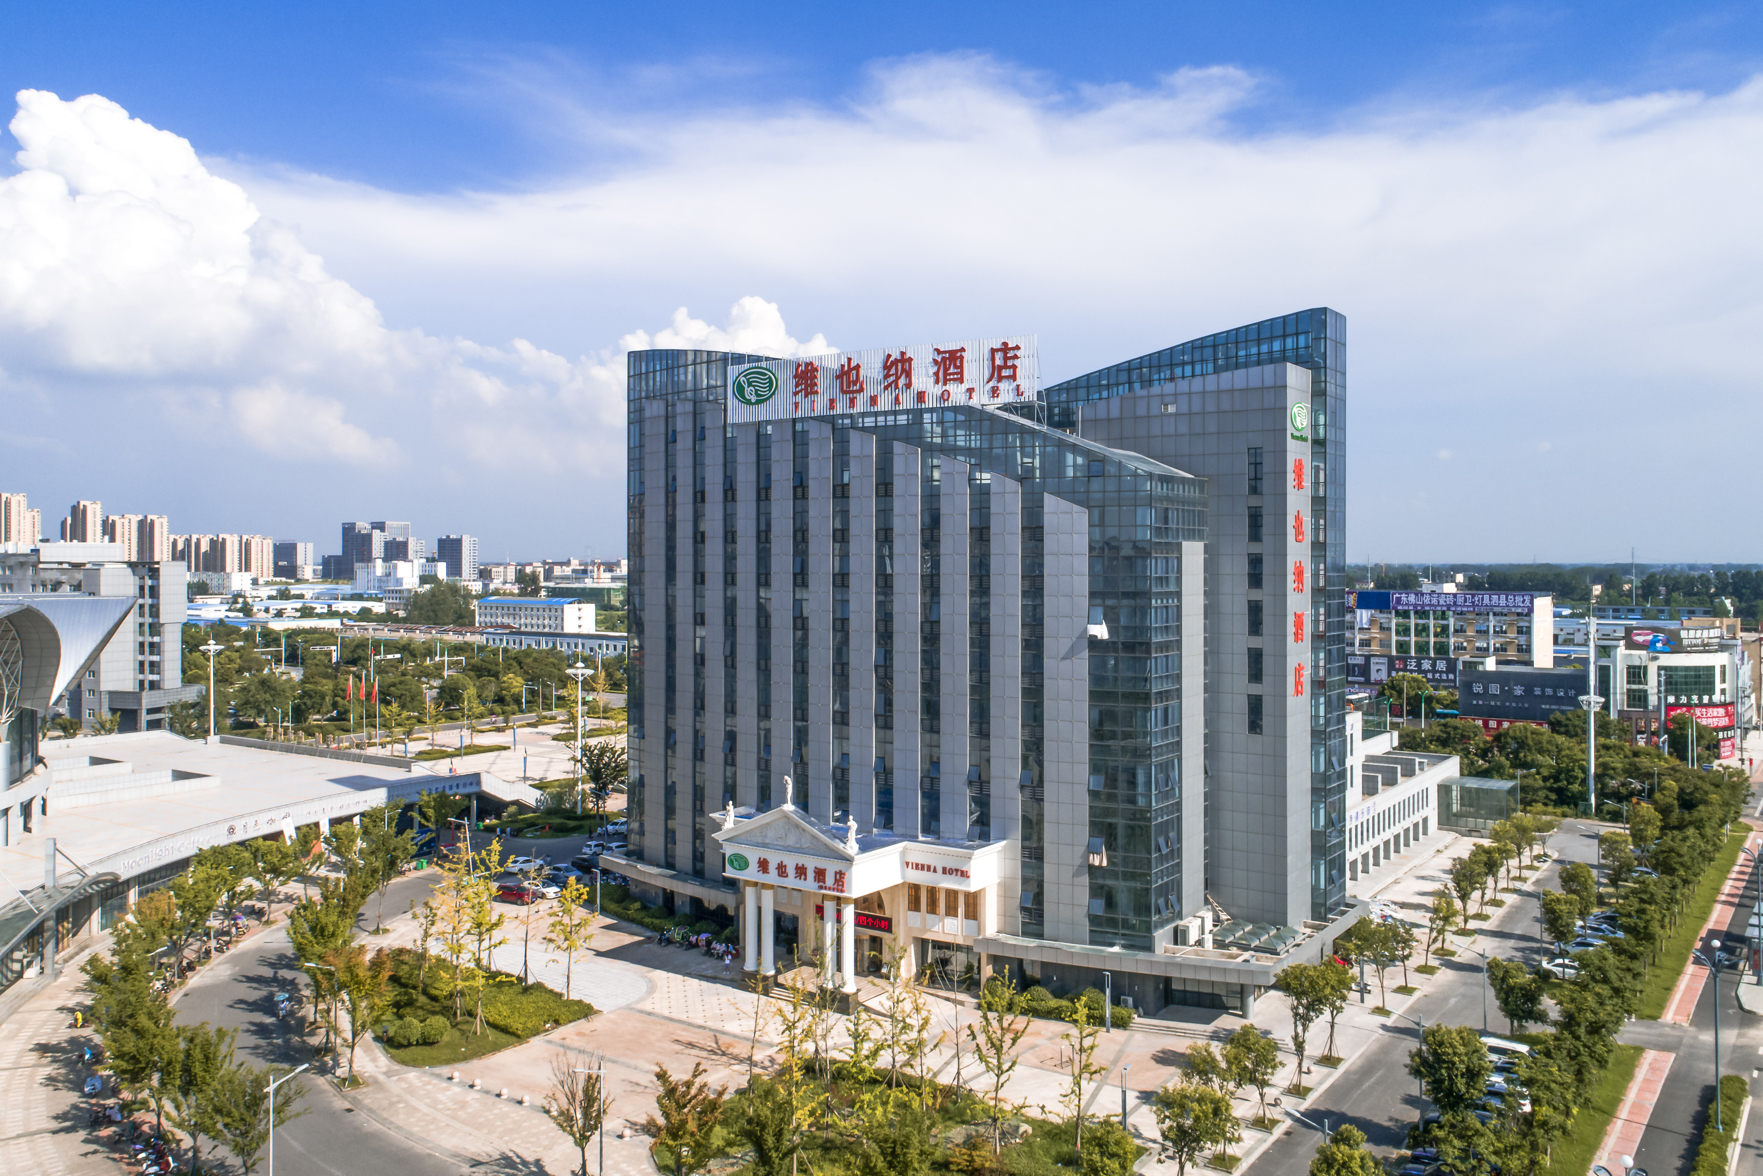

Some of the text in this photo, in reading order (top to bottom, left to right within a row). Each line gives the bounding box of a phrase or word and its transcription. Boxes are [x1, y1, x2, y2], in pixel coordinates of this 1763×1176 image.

[793, 341, 1022, 396] 维也纳酒店
[793, 382, 1025, 413] VIENNA HOTEL
[1292, 458, 1305, 697] 维也纳酒店
[1406, 659, 1447, 671] 泛家居
[1533, 687, 1577, 697] 装饰设计
[121, 835, 212, 873] Moonlight Coffee
[756, 857, 848, 888] 维也纳酒店
[905, 861, 971, 879] VIENNA HOTEL
